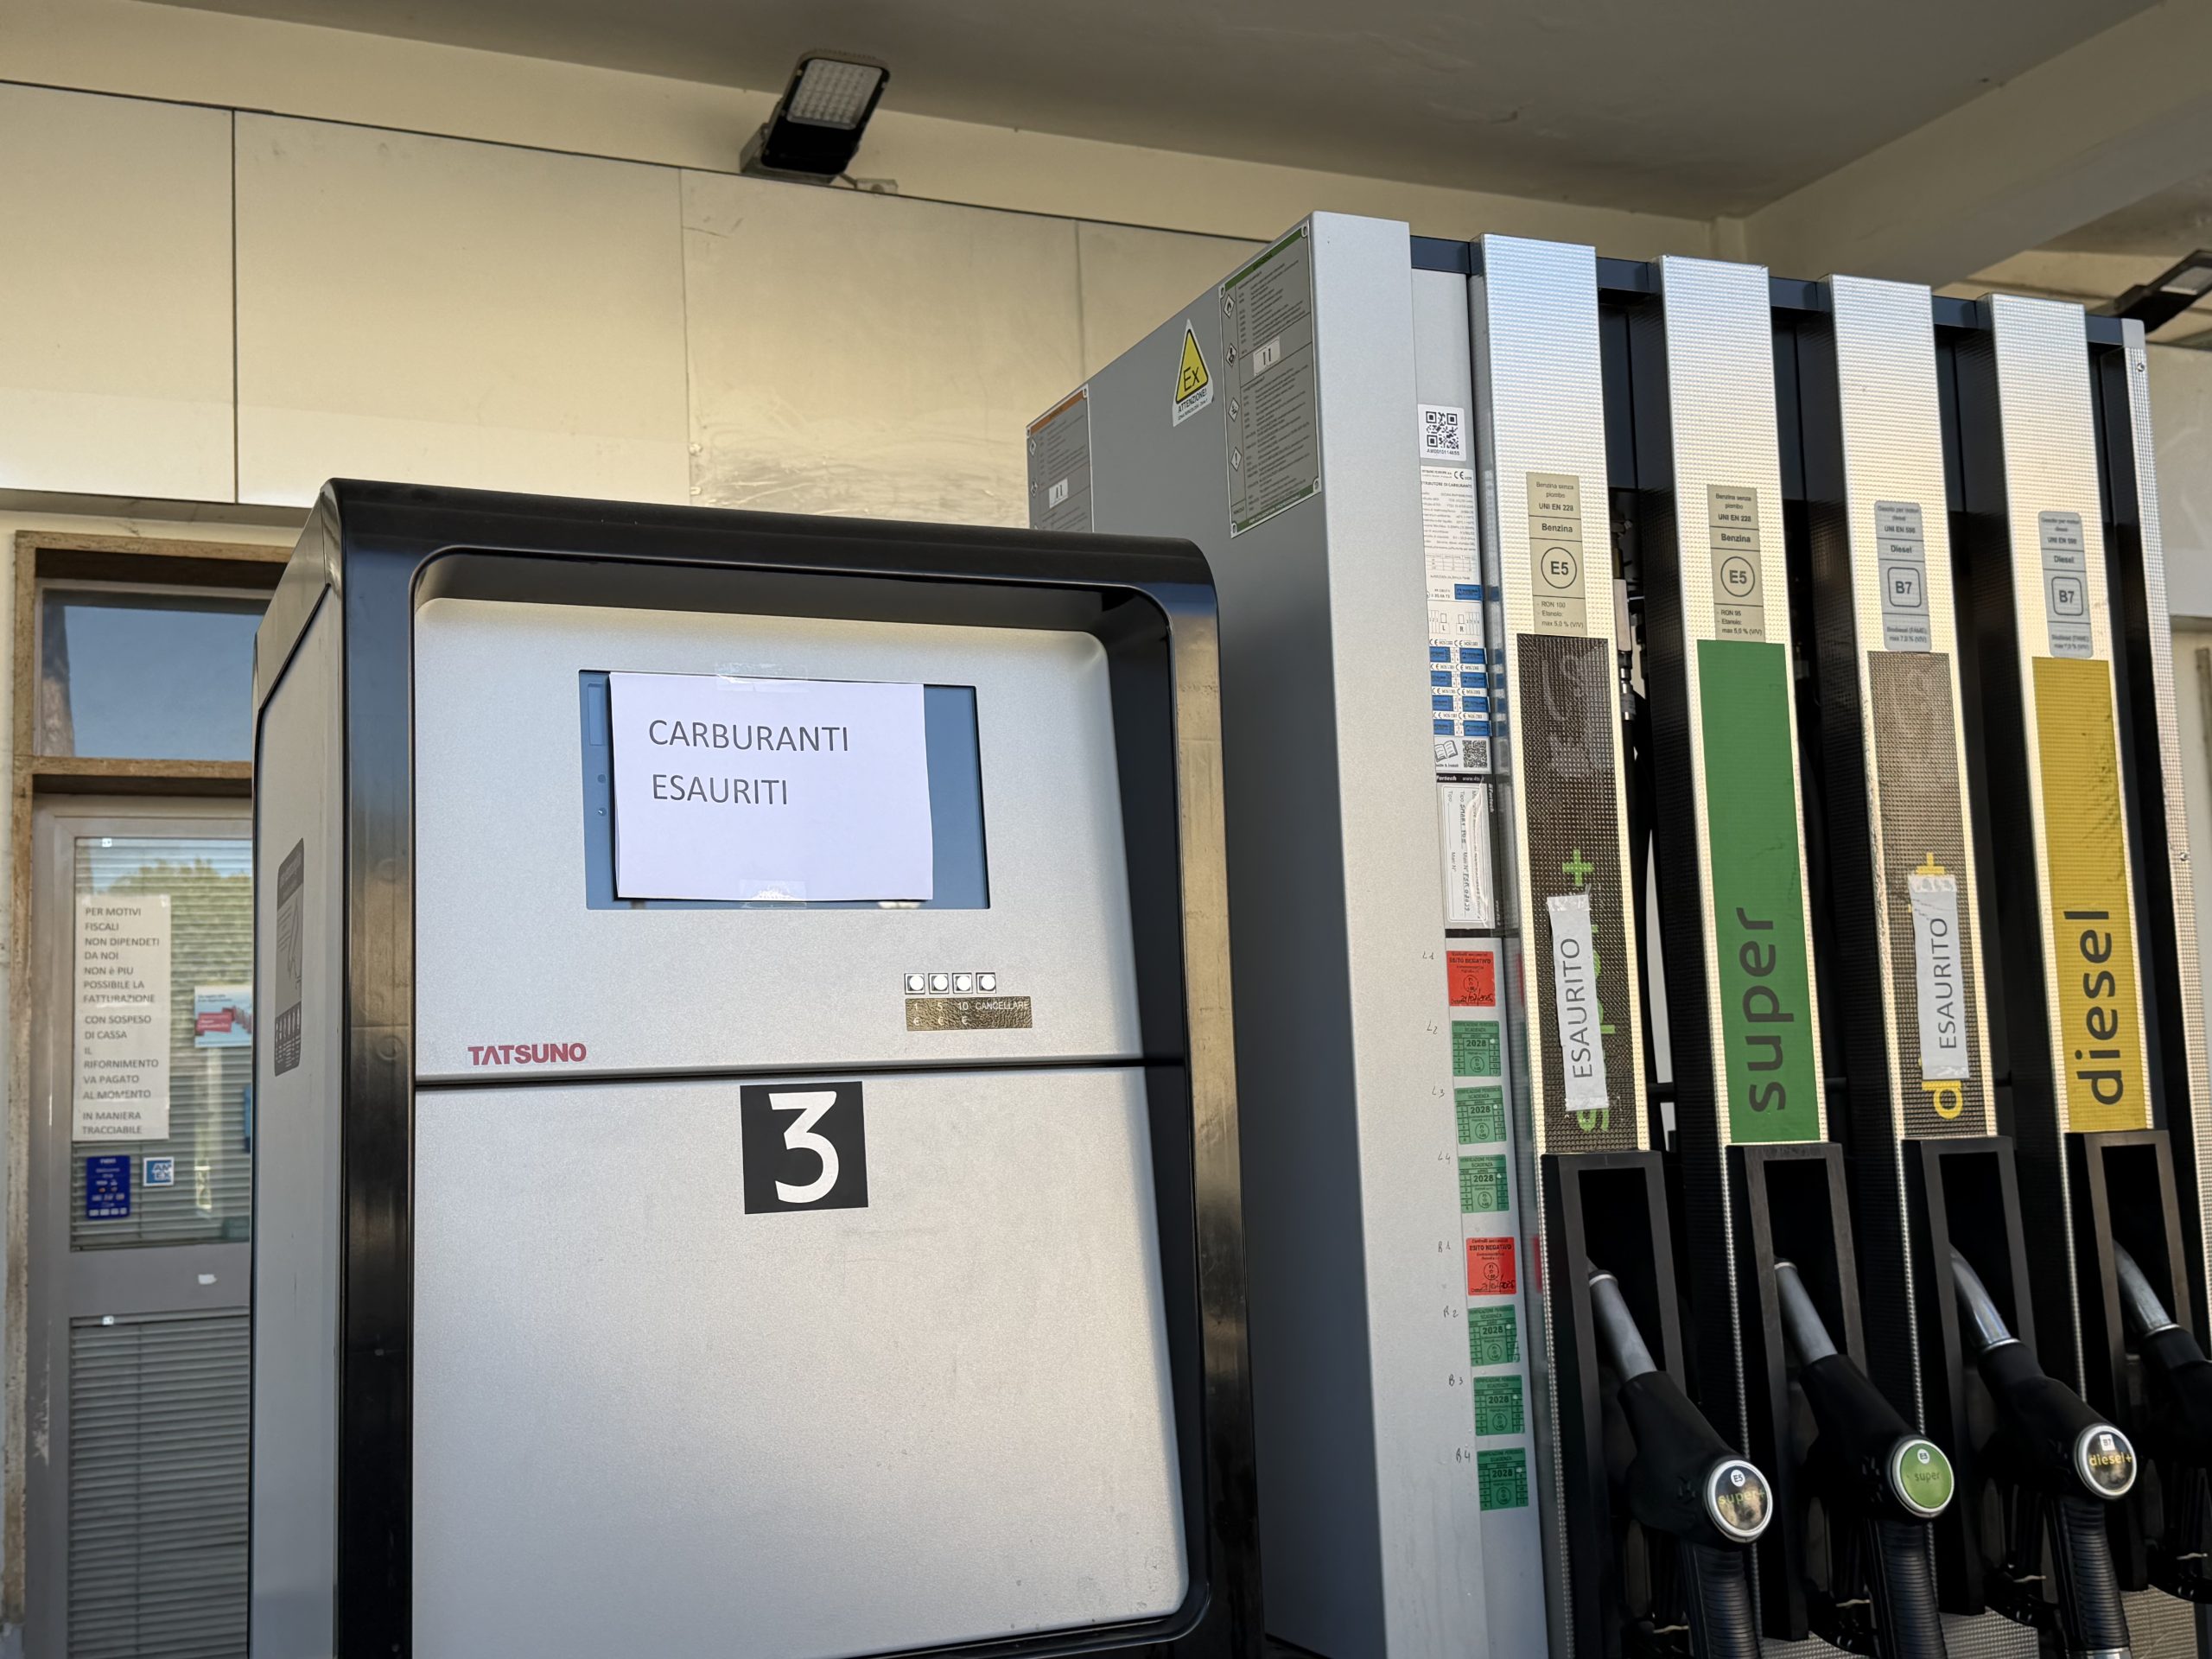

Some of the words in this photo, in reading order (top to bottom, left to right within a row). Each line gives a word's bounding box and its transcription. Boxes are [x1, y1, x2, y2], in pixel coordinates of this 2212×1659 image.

[1183, 366, 1200, 392] Ex
[1178, 388, 1207, 413] ATTENZIONE!
[1541, 523, 1573, 533] Benzina
[1720, 533, 1751, 543] Benzina
[1891, 544, 1912, 553] Diesel
[1550, 561, 1569, 575] E5
[1729, 569, 1747, 584] E5
[1895, 581, 1912, 594] B7
[2059, 589, 2075, 604] B7
[648, 719, 850, 752] CARBURANTI
[652, 773, 789, 805] ESAURITI
[85, 907, 103, 916] PER
[105, 907, 142, 916] MOTIVI
[85, 923, 119, 931] FISCALI
[85, 938, 107, 946] NON
[84, 951, 99, 960] DA
[100, 951, 118, 960] NOI
[84, 967, 106, 976] NON
[83, 980, 130, 989] POSSIBILE
[132, 980, 145, 989] LA
[1930, 918, 1957, 1049] ESAURITO
[83, 994, 156, 1003] FATTURAZIONE
[914, 1003, 918, 1012] 1
[938, 1002, 944, 1011] 5
[959, 1001, 969, 1011] 10
[976, 1001, 1030, 1010] CANCELLARE
[1560, 937, 1593, 1078] ESAURITO
[1736, 907, 1795, 1113] super
[2063, 910, 2124, 1106] diesel
[85, 1015, 106, 1025] CON
[108, 1015, 152, 1024] SOSPESO
[85, 1031, 95, 1040] DI
[97, 1030, 128, 1039] CASSA
[84, 1046, 92, 1055] IL
[467, 1042, 587, 1066] TATSUNO
[84, 1058, 159, 1069] RIFORNIMENTO
[83, 1075, 97, 1084] VA
[99, 1075, 140, 1084] PAGATO
[83, 1090, 94, 1100] AL
[97, 1089, 151, 1100] MOMENTO
[1470, 1105, 1491, 1114] 2028
[82, 1112, 93, 1121] IN
[95, 1111, 142, 1121] MANIERA
[82, 1125, 143, 1135] TRACCIABILE
[768, 1090, 840, 1204] 3
[1473, 1174, 1494, 1183] 2028
[1483, 1325, 1503, 1335] 2028
[1488, 1395, 1510, 1404] 2028
[2088, 1452, 2132, 1466] diesel+
[1491, 1468, 1513, 1478] 2028
[1914, 1471, 1941, 1483] super
[1732, 1474, 1744, 1483] E5
[1718, 1487, 1766, 1505] super+
